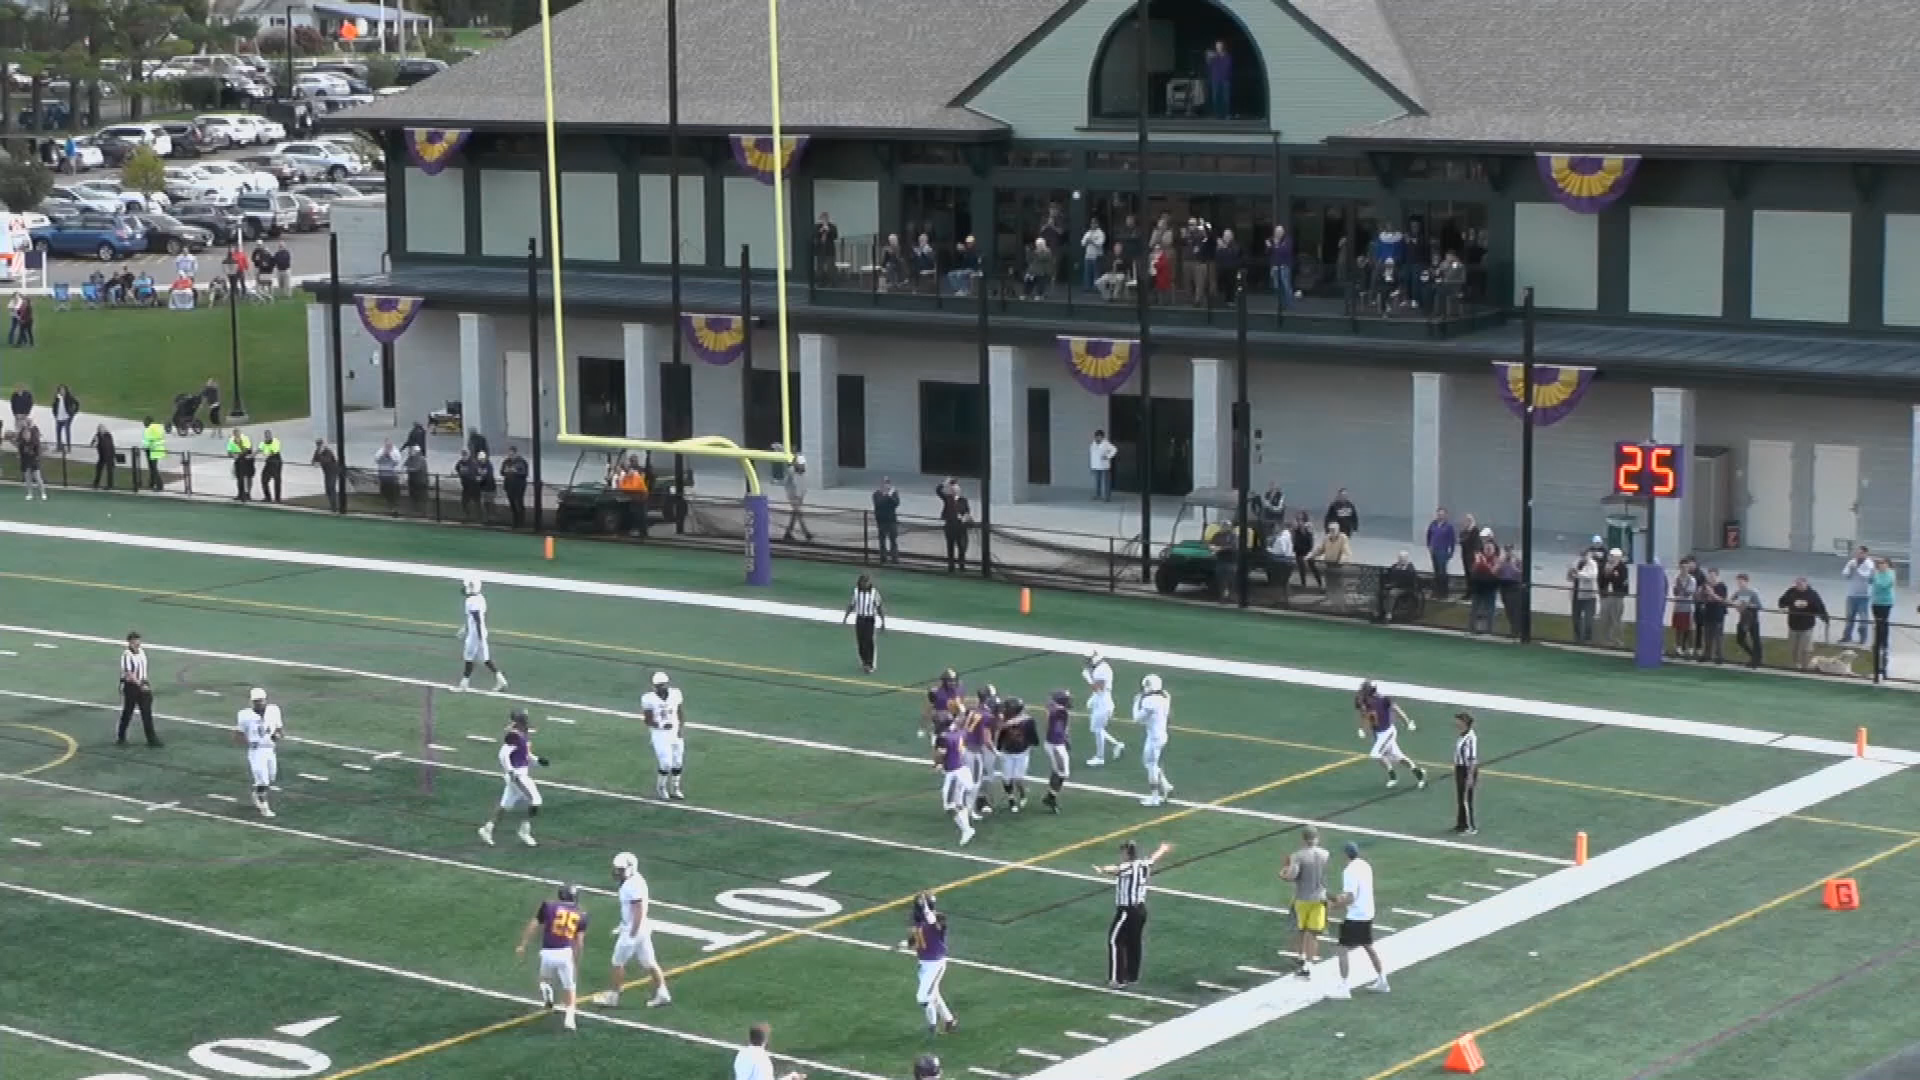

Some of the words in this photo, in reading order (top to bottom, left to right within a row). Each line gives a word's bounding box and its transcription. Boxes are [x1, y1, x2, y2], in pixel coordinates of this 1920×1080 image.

[1618, 445, 1675, 494] 25
[1835, 883, 1855, 905] G
[551, 905, 581, 939] 25
[612, 887, 843, 953] 10
